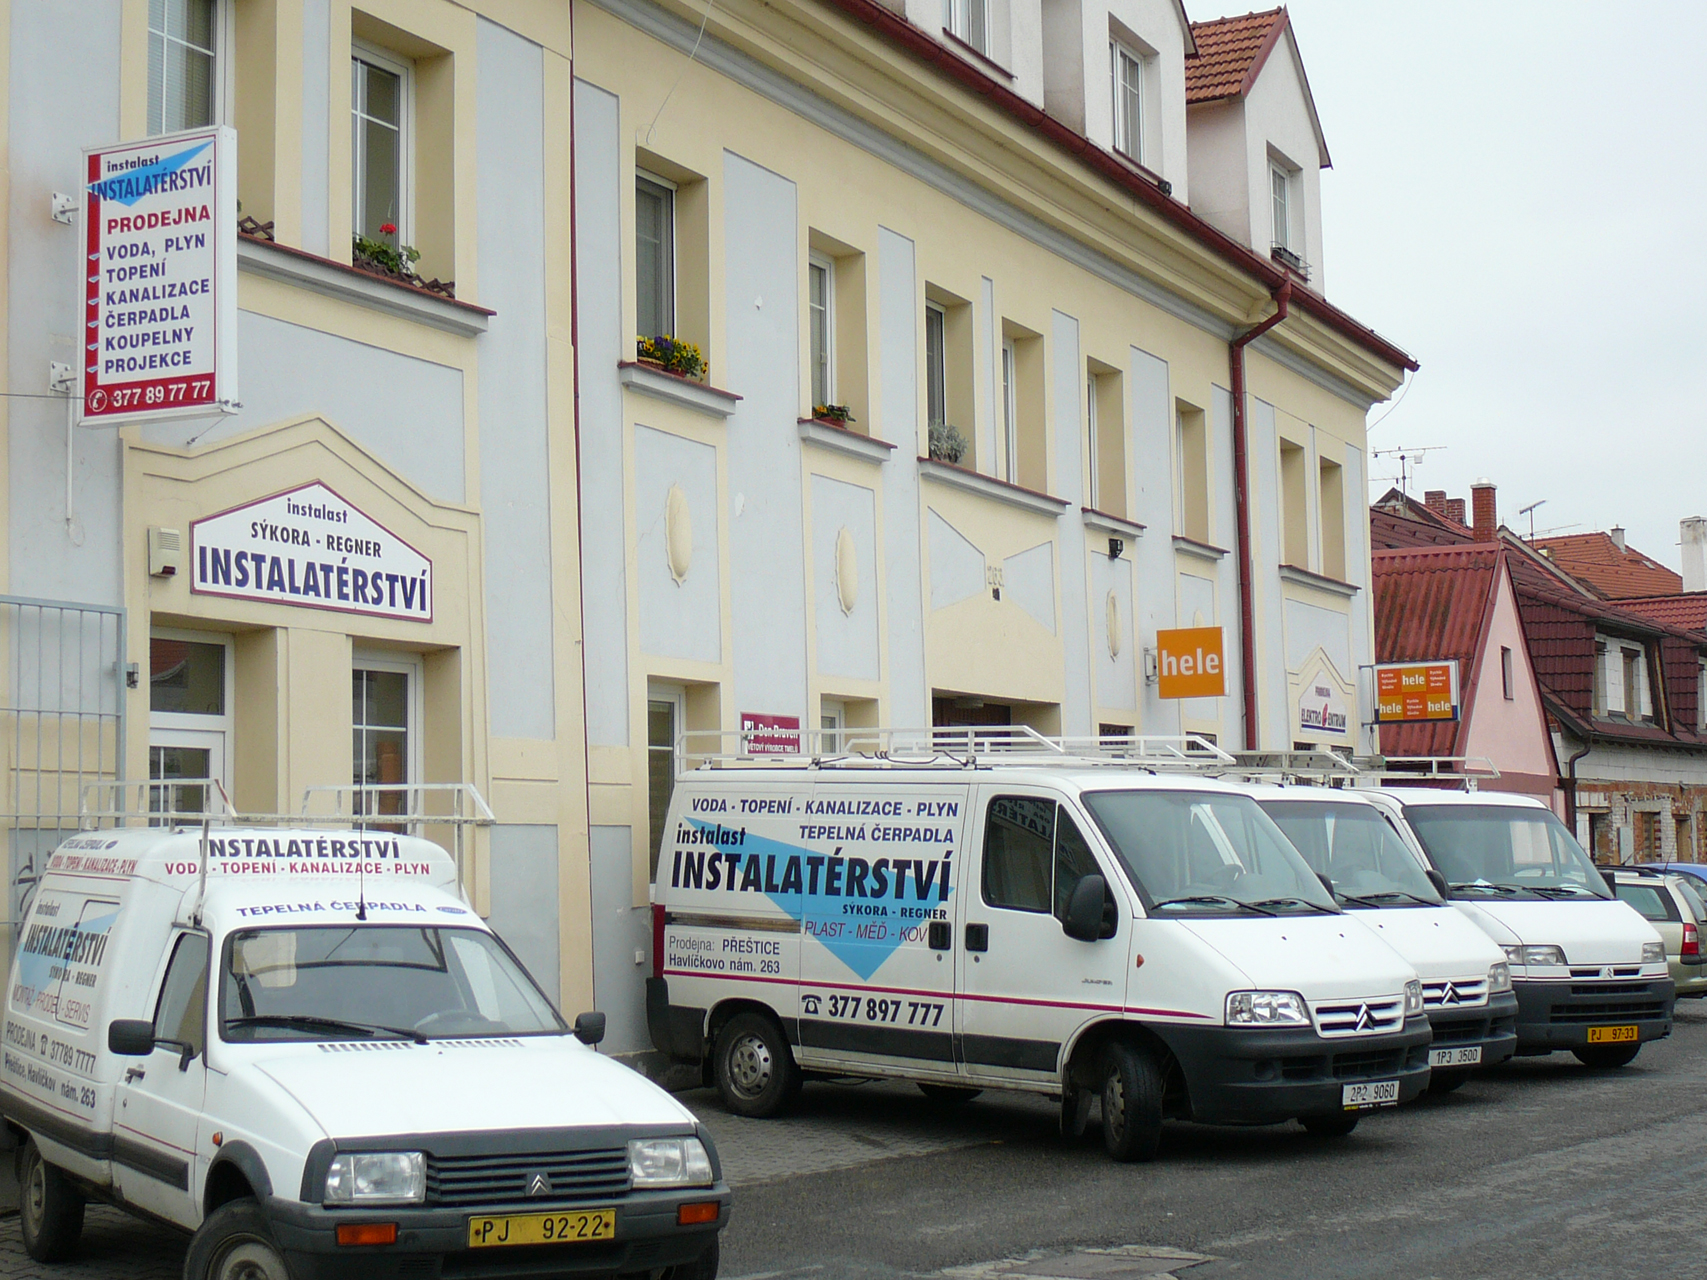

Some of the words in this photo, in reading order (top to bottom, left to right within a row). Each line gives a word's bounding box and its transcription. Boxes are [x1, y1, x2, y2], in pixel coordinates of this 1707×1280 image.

[107, 155, 160, 173] instalast
[91, 160, 211, 202] INSTALATÉRSTVÍ
[107, 204, 211, 234] PRODEJNA
[106, 241, 156, 261] VODA,
[164, 233, 205, 253] PLYN
[106, 258, 166, 283] TOPENÍ
[106, 278, 210, 306] KANALIZACE
[105, 305, 190, 329] ČERPADLA
[105, 327, 194, 351] KOUPELNY
[104, 350, 192, 374] PROJEKCE
[113, 388, 142, 407] 377
[146, 386, 164, 404] 89
[168, 383, 187, 401] 77
[192, 380, 211, 399] 77
[287, 497, 348, 524] instalast
[250, 519, 311, 547] SÝKORA
[326, 534, 382, 558] REGNER
[199, 545, 428, 612] INSTALATÉRSTVÍ
[1162, 648, 1220, 676] hele
[1402, 674, 1425, 686] hele
[1379, 702, 1402, 714] hele
[1427, 700, 1451, 712] hele
[692, 798, 727, 812] VODA
[740, 796, 794, 814] TOPENÍ
[805, 800, 903, 816] KANALIZACE
[916, 802, 959, 817] PLYN
[676, 822, 746, 846] instalast
[799, 823, 866, 841] TEPELNÁ
[871, 823, 954, 844] ČERPADLA
[221, 859, 276, 874] TOPENÍ
[289, 862, 383, 874] KANALIZACE
[395, 863, 430, 875] PLYN
[671, 847, 954, 902] INSTALATÉRSTVÍ
[236, 901, 326, 917] TEPELNÁ
[842, 901, 888, 917] SÝKORA
[900, 907, 947, 920] REGNER
[804, 920, 846, 938] PLAST
[856, 920, 887, 940] MĚĎ
[899, 926, 929, 943] KOV
[23, 923, 112, 967] INSTALATÉRSTVÍ
[669, 935, 715, 953] Prodejna:
[722, 936, 780, 955] PŘEŠTICE
[669, 952, 725, 970] Havlíčkovo
[729, 957, 757, 972] nám.
[760, 959, 780, 974] 263
[75, 971, 97, 988] REGNER
[65, 999, 91, 1023] SERVIS
[828, 994, 862, 1019] 377
[866, 998, 902, 1023] 897
[908, 1001, 945, 1027] 777
[6, 1020, 36, 1051] PRODEJNA
[1591, 1029, 1601, 1041] PJ
[1612, 1027, 1634, 1040] 97-33
[50, 1039, 74, 1067] 37789
[75, 1048, 97, 1074] 7777
[1436, 1051, 1452, 1064] 1P3
[1458, 1048, 1479, 1063] 3500
[80, 1086, 96, 1109] 263
[1350, 1085, 1368, 1102] 2P2
[1373, 1083, 1395, 1100] 9060
[481, 1219, 510, 1244] PJ
[543, 1214, 604, 1240] 92-22
